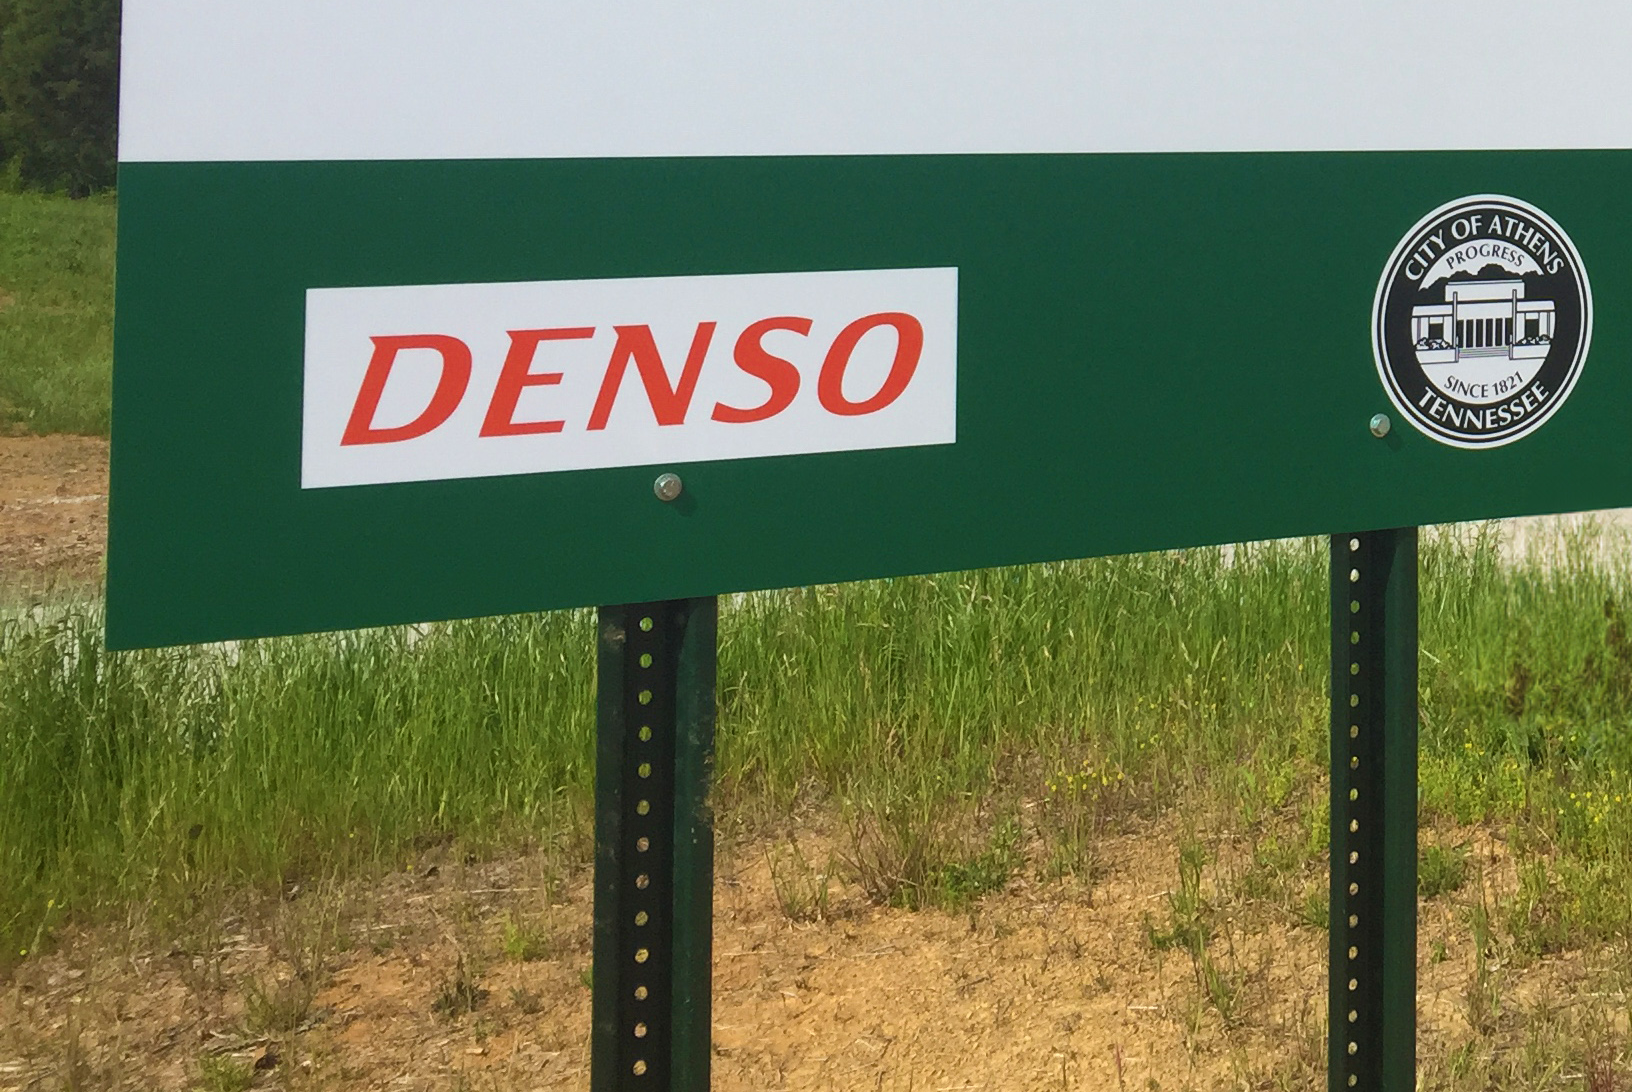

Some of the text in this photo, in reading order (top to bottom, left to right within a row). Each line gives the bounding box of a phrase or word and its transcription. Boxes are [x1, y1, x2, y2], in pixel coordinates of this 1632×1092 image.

[1405, 214, 1565, 281] CITY OF ATHENS
[1446, 244, 1524, 269] PROGRESS
[340, 312, 924, 446] DENSO
[1444, 371, 1524, 398] SINCE 1821
[1417, 381, 1550, 430] TENNESSEE
